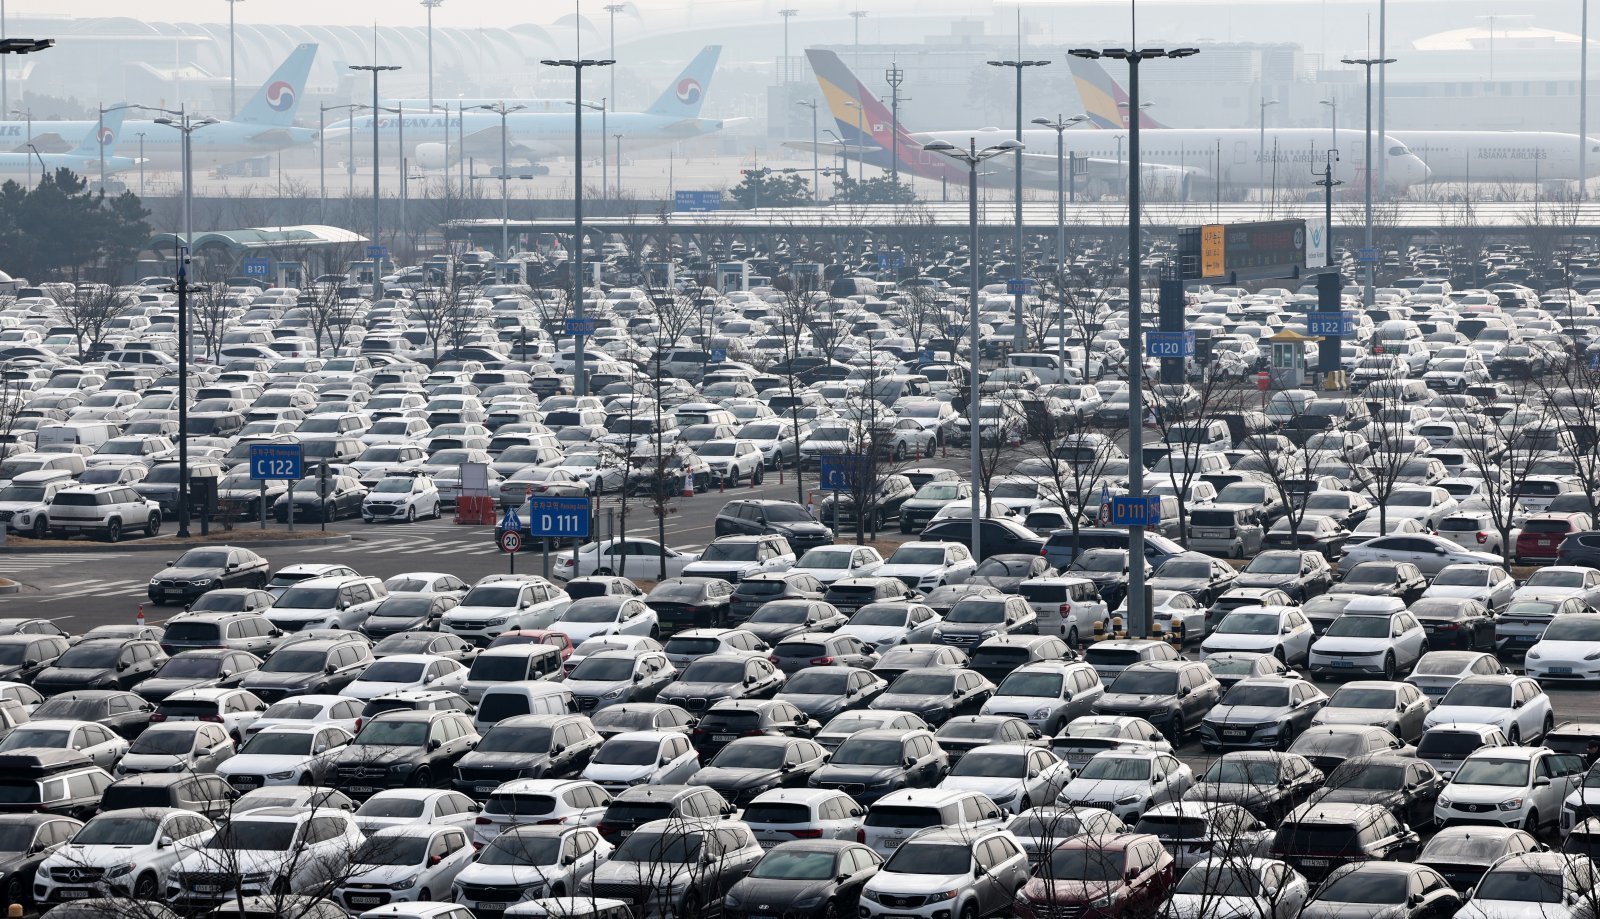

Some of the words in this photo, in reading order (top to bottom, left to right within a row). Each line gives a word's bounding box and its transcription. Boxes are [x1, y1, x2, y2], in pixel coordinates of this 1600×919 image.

[1256, 154, 1289, 163] ASIANA
[1292, 154, 1333, 163] AIRLINES
[1477, 151, 1508, 160] ASIANA
[1510, 151, 1547, 160] AIRLINES
[254, 265, 265, 274] 121
[1312, 322, 1319, 333] B
[1321, 322, 1338, 333] 122
[1151, 342, 1157, 354] C
[1159, 342, 1179, 354] 120
[258, 460, 265, 475] C
[269, 460, 293, 475] 122
[1117, 503, 1125, 518] D
[1128, 504, 1144, 519] 111
[542, 514, 552, 531] D
[557, 514, 578, 532] 111
[506, 537, 517, 546] 20
